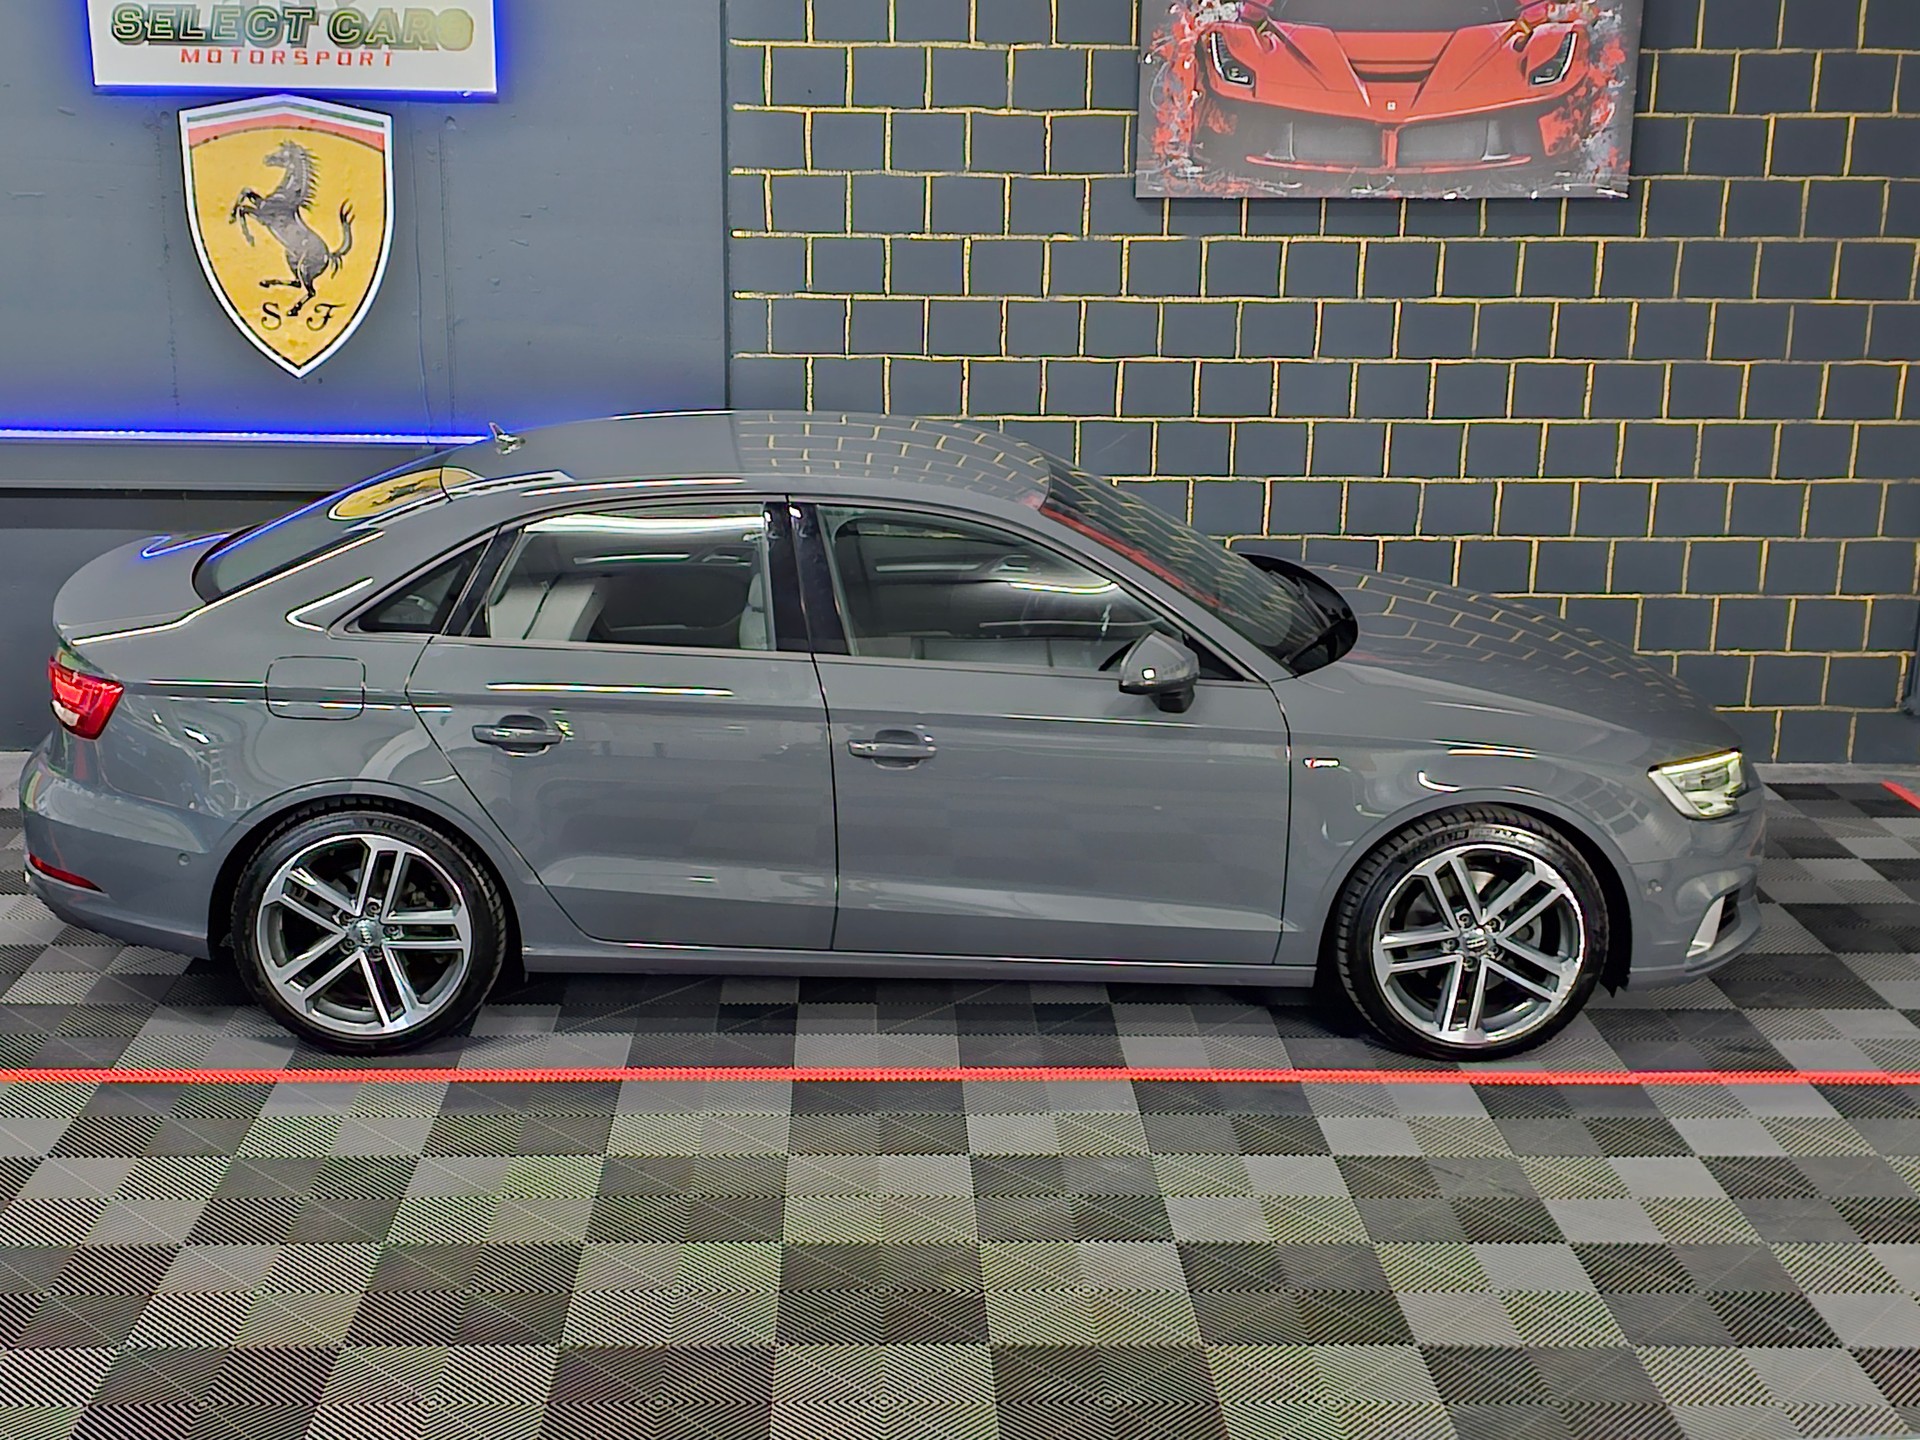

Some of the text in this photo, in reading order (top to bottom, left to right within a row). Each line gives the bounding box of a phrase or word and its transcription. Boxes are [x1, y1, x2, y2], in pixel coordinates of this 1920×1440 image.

[112, 3, 319, 48] SELECT
[180, 48, 394, 67] MOTORSPORT
[261, 302, 347, 332] S F
